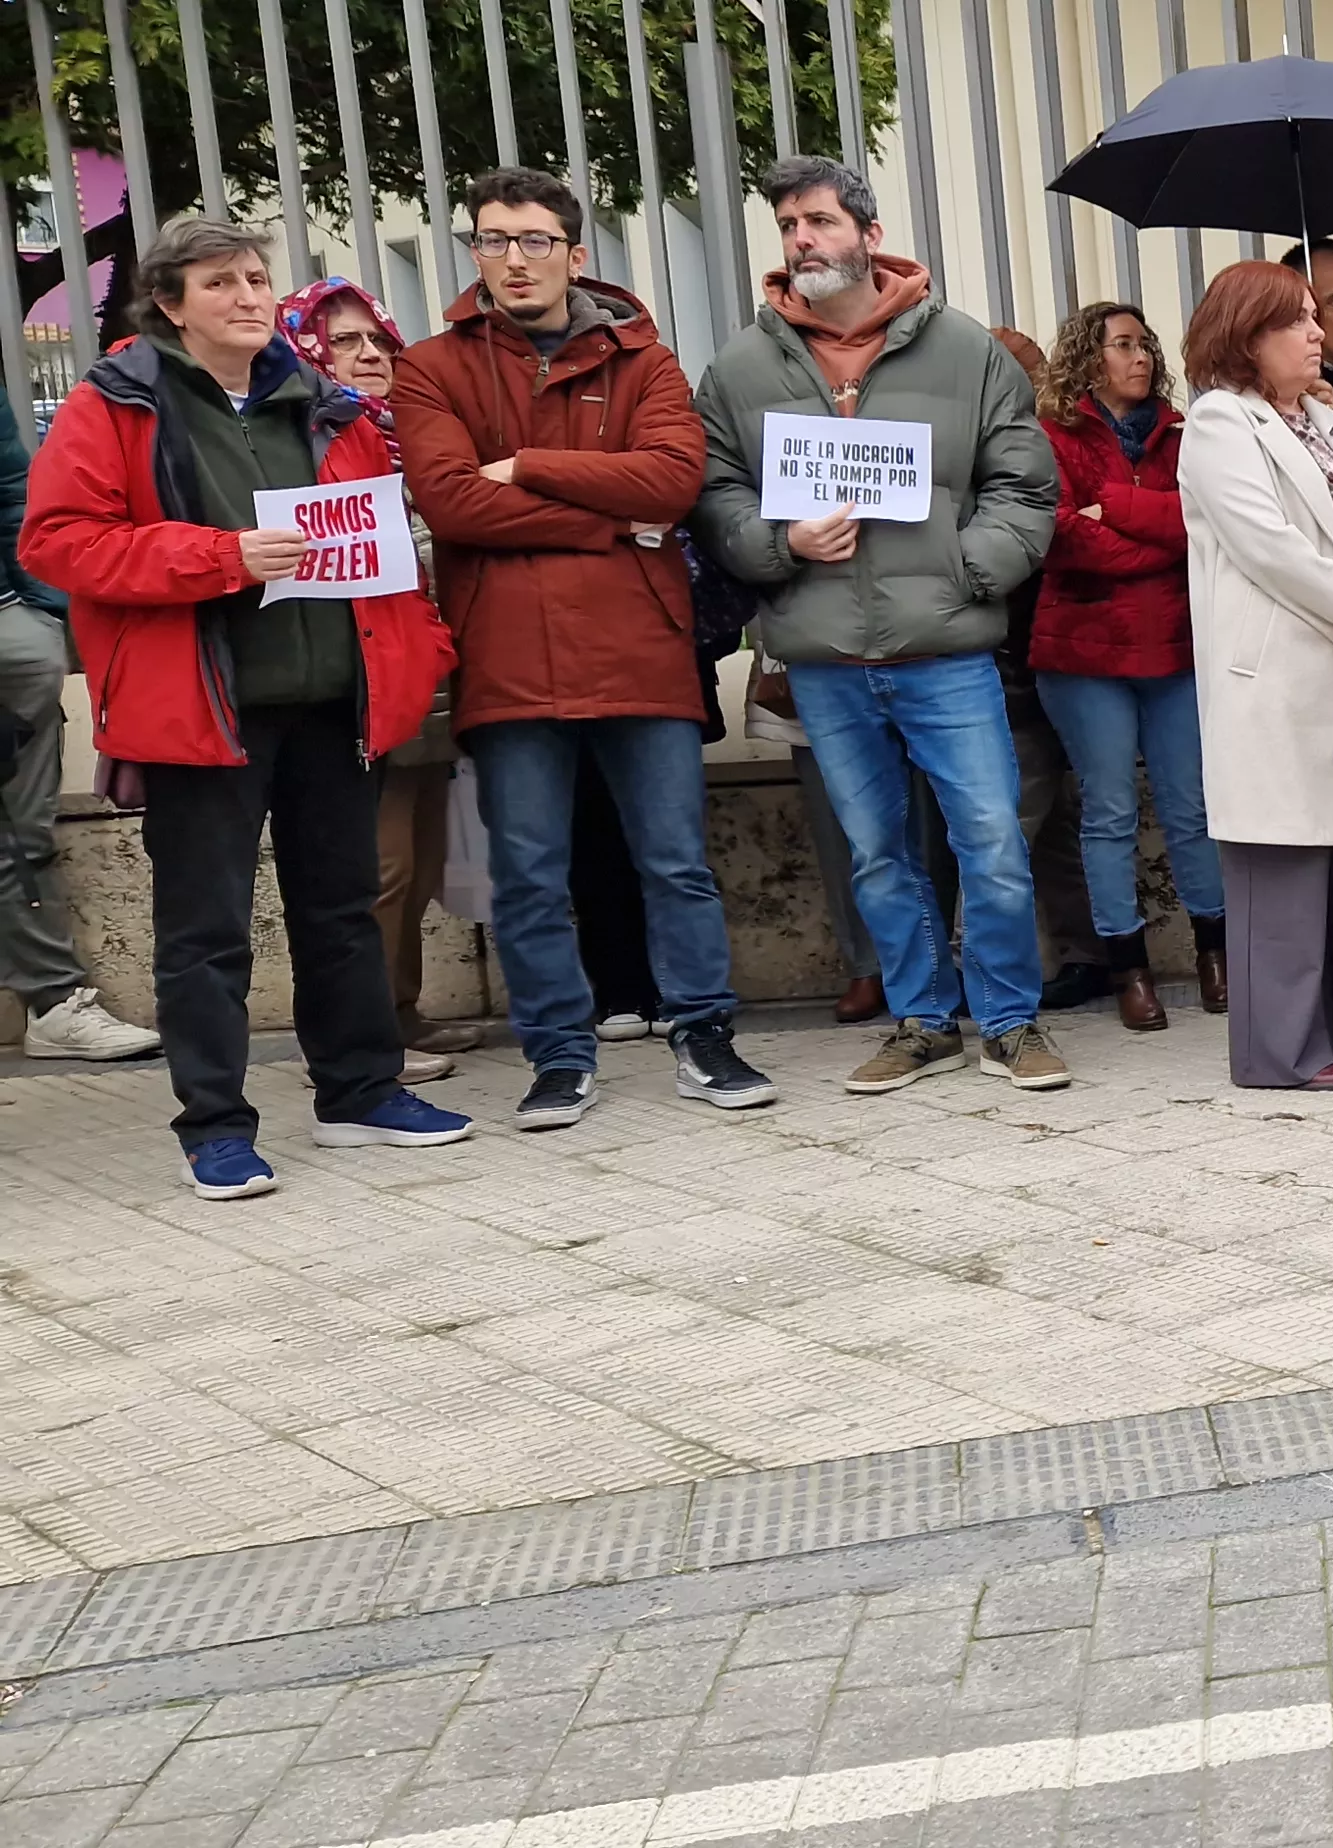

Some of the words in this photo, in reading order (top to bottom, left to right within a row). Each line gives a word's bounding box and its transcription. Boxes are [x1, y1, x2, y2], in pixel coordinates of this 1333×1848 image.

[783, 438, 811, 456] QUE
[818, 441, 835, 459] LA
[842, 442, 914, 465] VOCACIÓN
[779, 459, 798, 477] NO
[805, 461, 822, 479] SE
[830, 463, 882, 485] ROMPA
[888, 469, 917, 487] POR
[814, 483, 829, 501] EL
[836, 485, 881, 505] MIEDO
[294, 492, 377, 542] SOMOS
[294, 535, 379, 582] BELÉN
